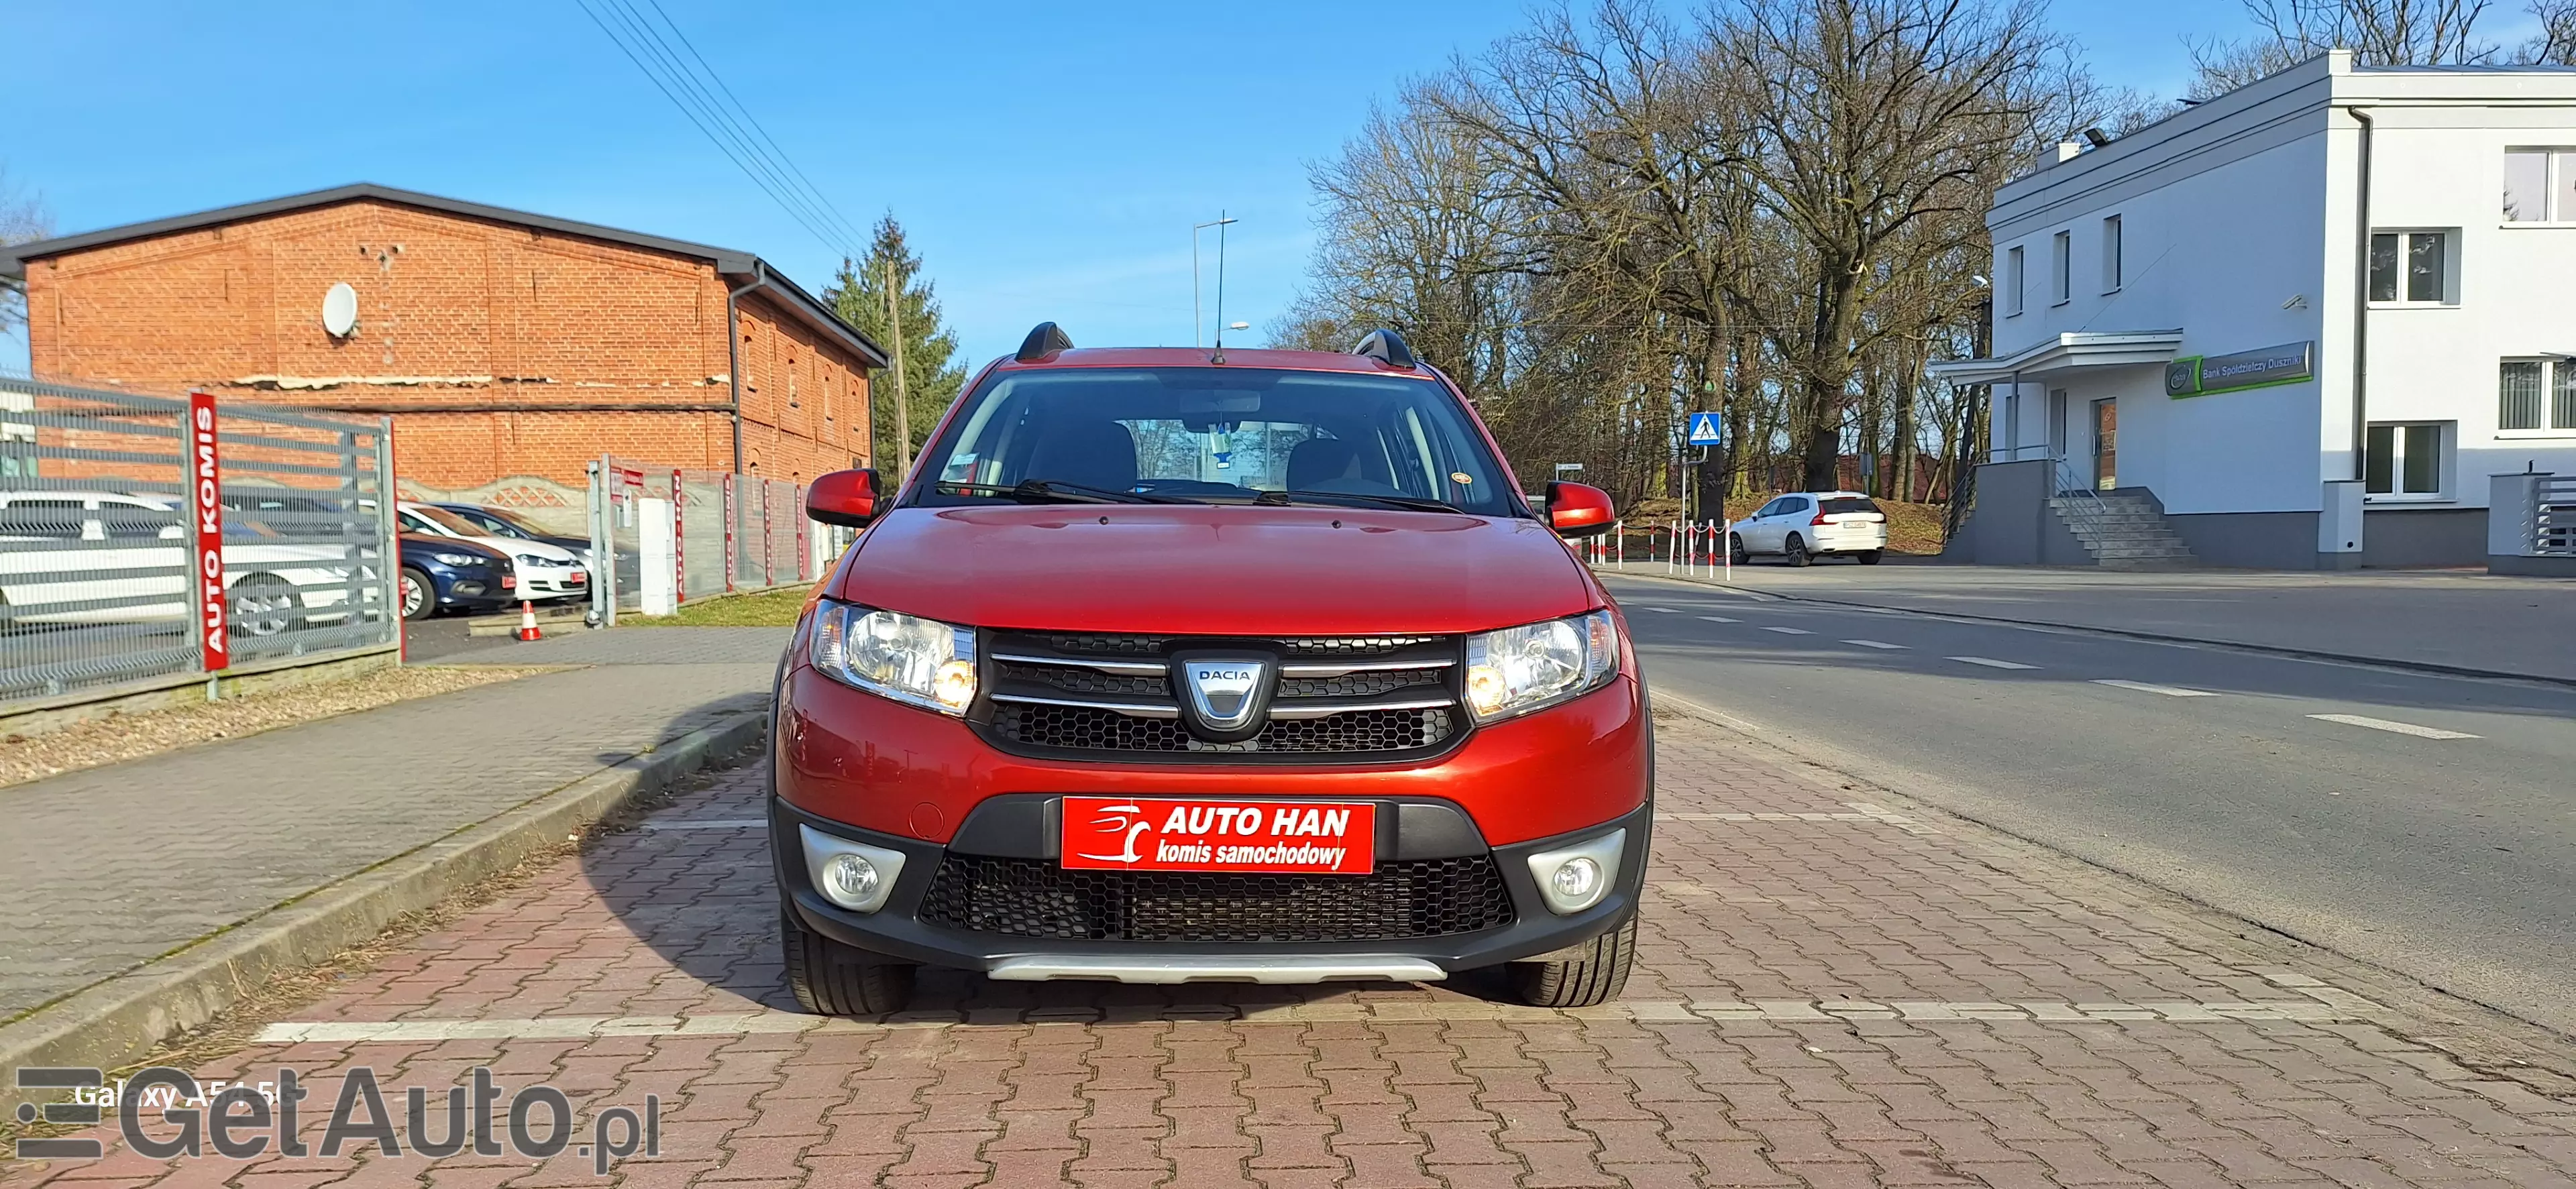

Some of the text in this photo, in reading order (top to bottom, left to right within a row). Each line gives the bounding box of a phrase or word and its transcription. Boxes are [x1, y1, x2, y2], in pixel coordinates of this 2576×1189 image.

[2203, 368, 2220, 379] Bank
[2268, 355, 2302, 369] Duszniki
[197, 406, 225, 653] AUTO KOMIS
[1199, 671, 1250, 680] DACIA
[1161, 806, 1350, 836] AUTO HAN
[1156, 839, 1346, 870] komis samochodowy
